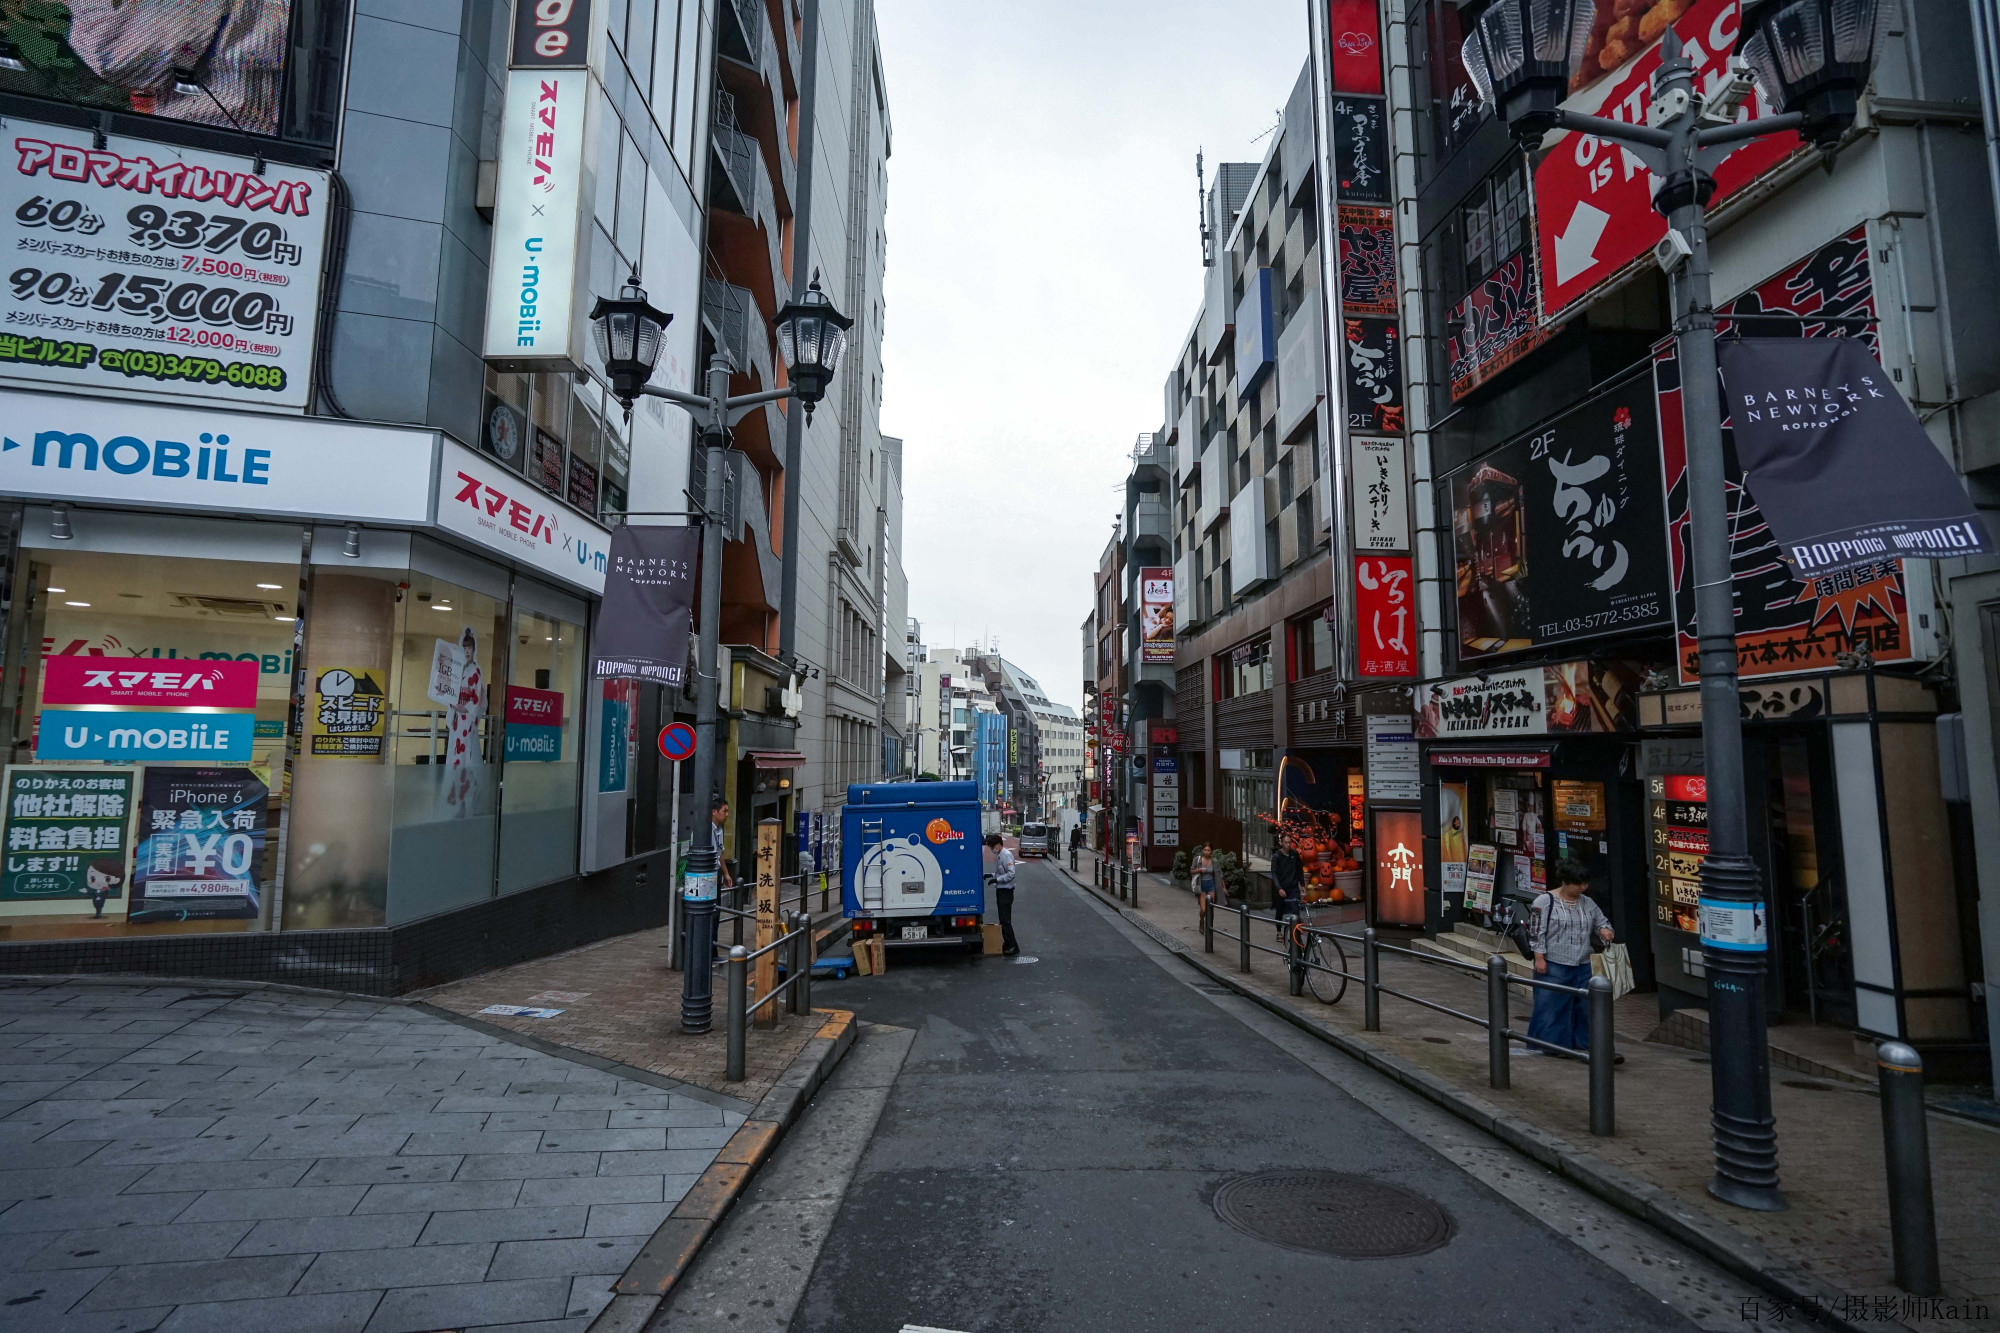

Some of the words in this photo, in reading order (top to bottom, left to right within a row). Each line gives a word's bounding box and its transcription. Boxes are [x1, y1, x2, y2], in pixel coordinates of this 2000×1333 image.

[1335, 101, 1354, 116] 4F
[14, 138, 312, 217] アロマオイルリンパ
[14, 195, 106, 236] 60分
[1378, 209, 1392, 219] 3F
[126, 204, 303, 267] 9,370円
[17, 238, 177, 270] メンバーズカードお持ちの方は
[8, 267, 93, 307] 90分
[91, 272, 294, 336] 15,000円
[6, 312, 166, 340] メンバーズカードお持ちの方は
[1743, 375, 1874, 407] BARNEYS
[1349, 413, 1373, 428] 2F
[1782, 407, 1859, 432] ROPPONGI
[1529, 429, 1557, 461] 2F
[1612, 421, 1630, 509] 琉球ダイニング
[1368, 483, 1381, 531] ステーキ
[1547, 447, 1630, 592] ちゅらり
[477, 517, 497, 532] SMART
[519, 537, 537, 551] PHONE
[1791, 537, 1887, 570] ROPPONGI
[1892, 521, 1980, 550] ROPPONGI
[617, 556, 689, 571] BARNEYS
[1358, 560, 1409, 656] いろは
[1538, 601, 1660, 638] TEL:03-5772-5385
[596, 659, 638, 675] ROPPONGI
[1364, 659, 1410, 674] 居酒屋
[319, 695, 381, 712] スピード
[318, 710, 379, 726] お見積り
[328, 724, 371, 734] はじめました
[1492, 715, 1530, 729] STEAK
[1522, 756, 1539, 765] Steak
[15, 778, 126, 790] のりかえのお客様
[1651, 779, 1665, 794] 5F
[13, 793, 125, 818] 他社解除
[169, 789, 228, 804] iPhone
[233, 790, 243, 804] 6
[151, 809, 257, 831] 緊急入荷
[1653, 805, 1667, 820] 4F
[9, 826, 121, 850] 料金負担
[935, 830, 964, 841] Reika
[1653, 829, 1668, 845] 3F
[153, 842, 174, 872] 実質
[1655, 854, 1669, 870] 2F
[758, 846, 775, 914] 芋洗坂
[1658, 880, 1670, 896] 1F
[1657, 905, 1673, 922] B1F
